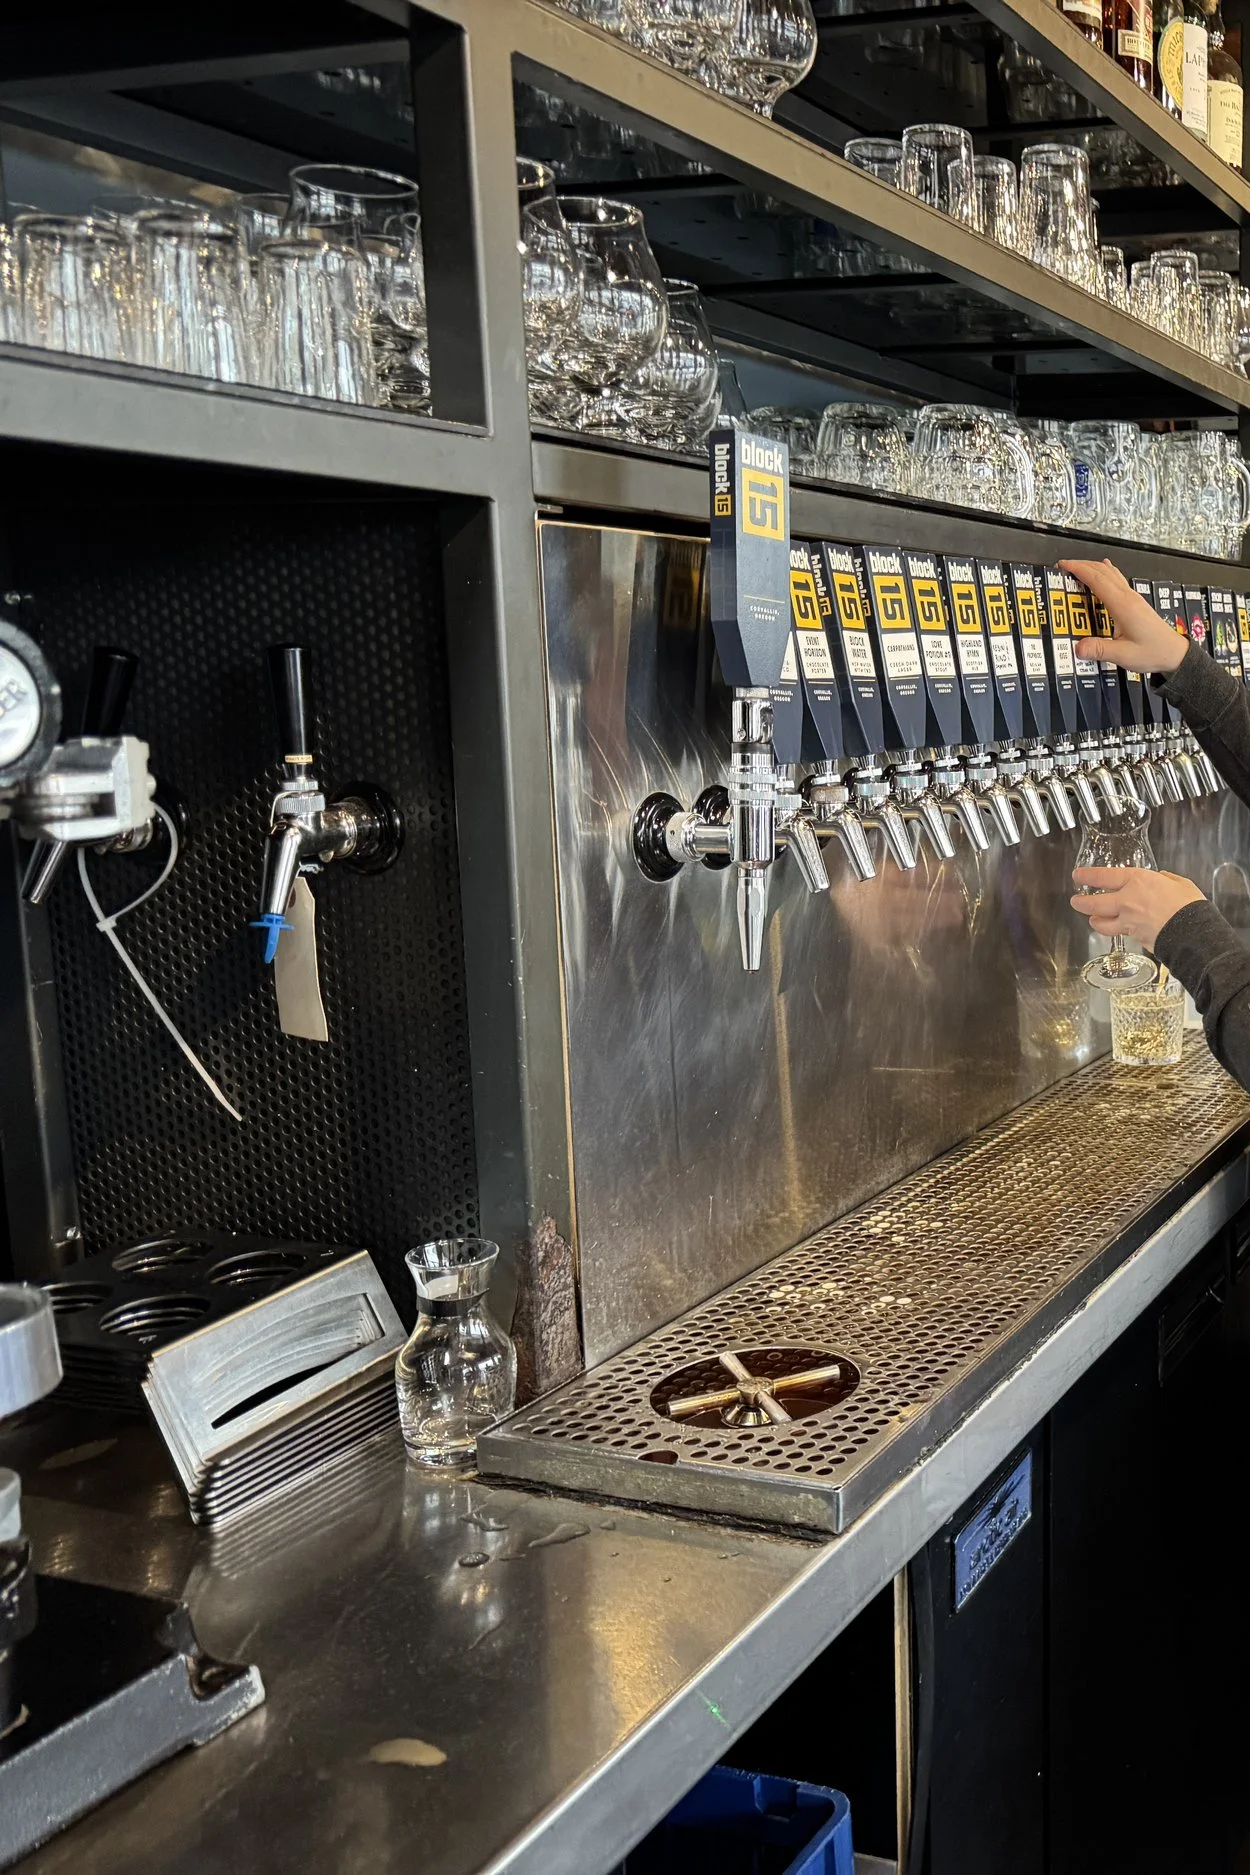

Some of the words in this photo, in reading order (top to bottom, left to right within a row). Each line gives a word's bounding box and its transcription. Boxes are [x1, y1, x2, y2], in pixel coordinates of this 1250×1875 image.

[715, 443, 731, 495] block
[741, 438, 784, 475] block
[717, 496, 730, 513] 15
[748, 480, 778, 532] 15
[790, 547, 811, 571] ock
[828, 547, 855, 573] block
[868, 551, 903, 574] block
[907, 556, 937, 579] block
[947, 561, 974, 582] block
[980, 565, 1003, 585] block
[1013, 569, 1034, 589] block
[1047, 571, 1065, 590] block
[792, 579, 817, 621] 15
[838, 580, 861, 621] 15
[879, 582, 906, 621] 15
[917, 586, 941, 623] 15
[956, 589, 977, 625] 15
[988, 591, 1007, 626] 15
[1020, 595, 1037, 629] 15
[1052, 596, 1066, 628] 15
[1071, 599, 1089, 630] 15
[804, 648, 827, 657] HORIZON
[805, 636, 820, 646] EVENT
[925, 650, 943, 659] POTION
